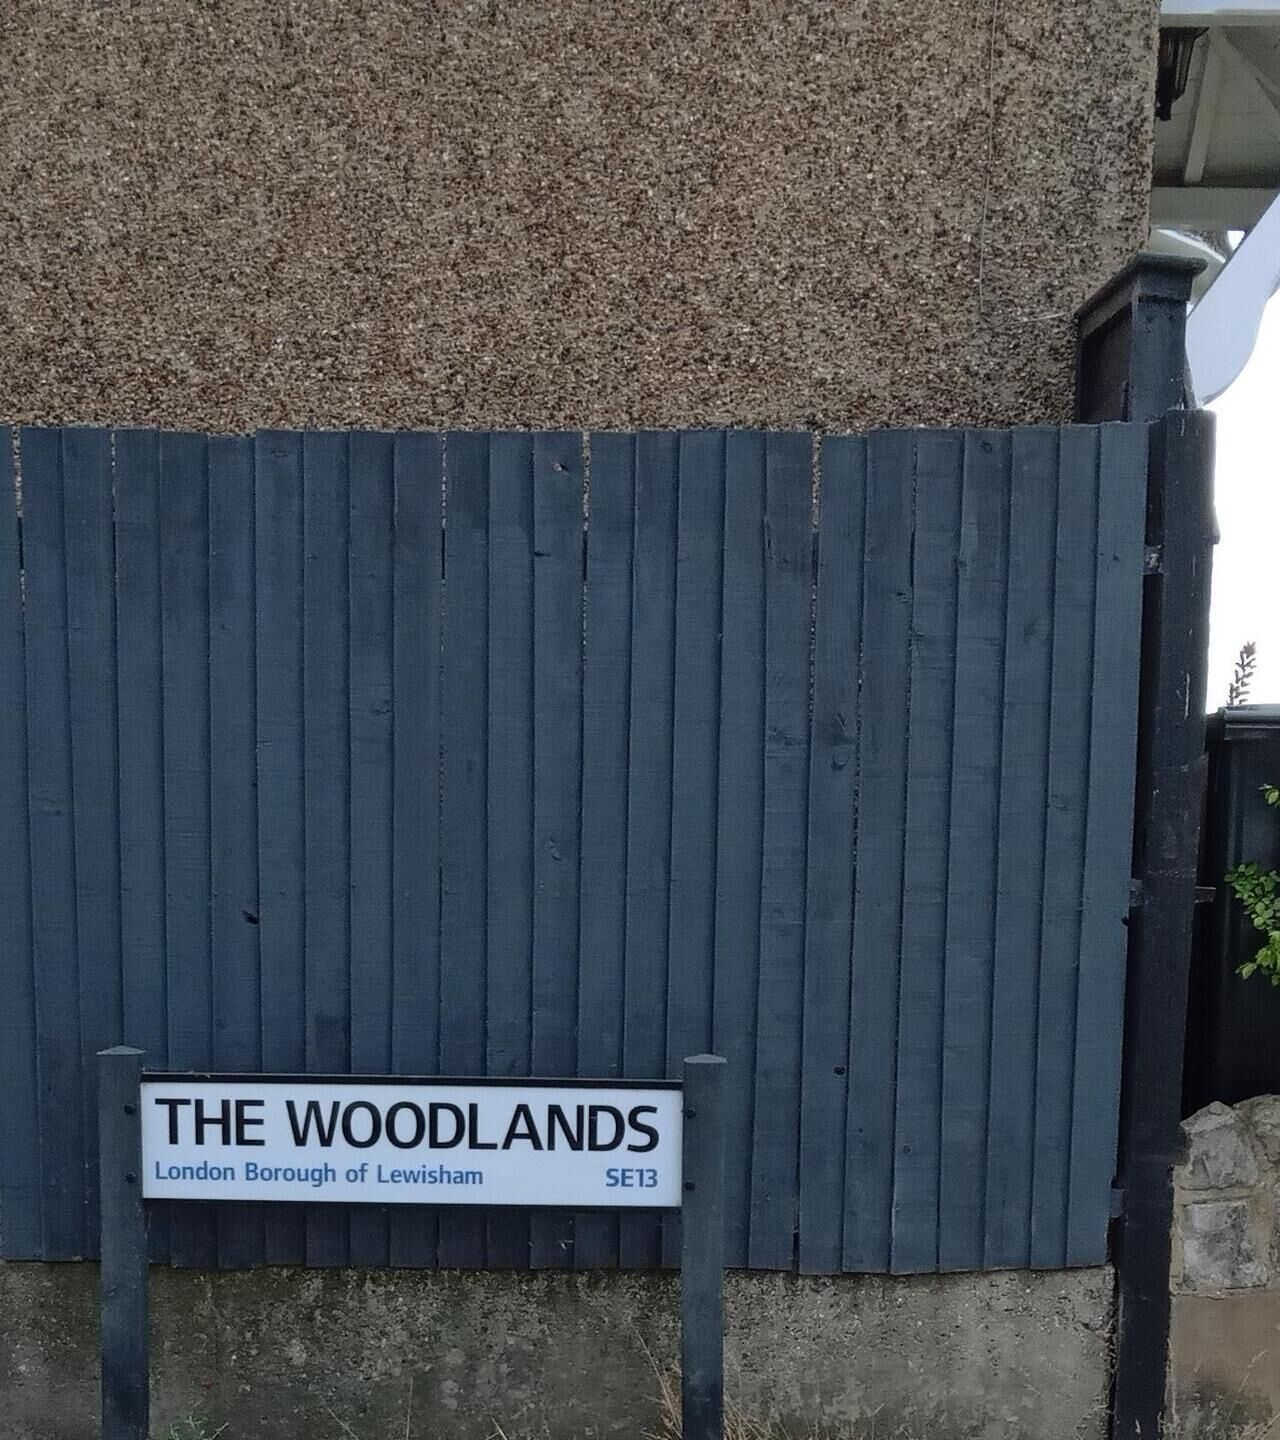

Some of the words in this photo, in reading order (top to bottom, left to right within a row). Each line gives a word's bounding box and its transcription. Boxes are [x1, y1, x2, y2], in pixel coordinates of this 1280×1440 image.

[154, 1098, 266, 1147] THE
[285, 1099, 660, 1153] WOODLANDS
[154, 1161, 236, 1182] London
[244, 1162, 337, 1187] Borough
[344, 1163, 370, 1184] of
[376, 1164, 484, 1186] Lewisham
[605, 1167, 659, 1189] SE13
